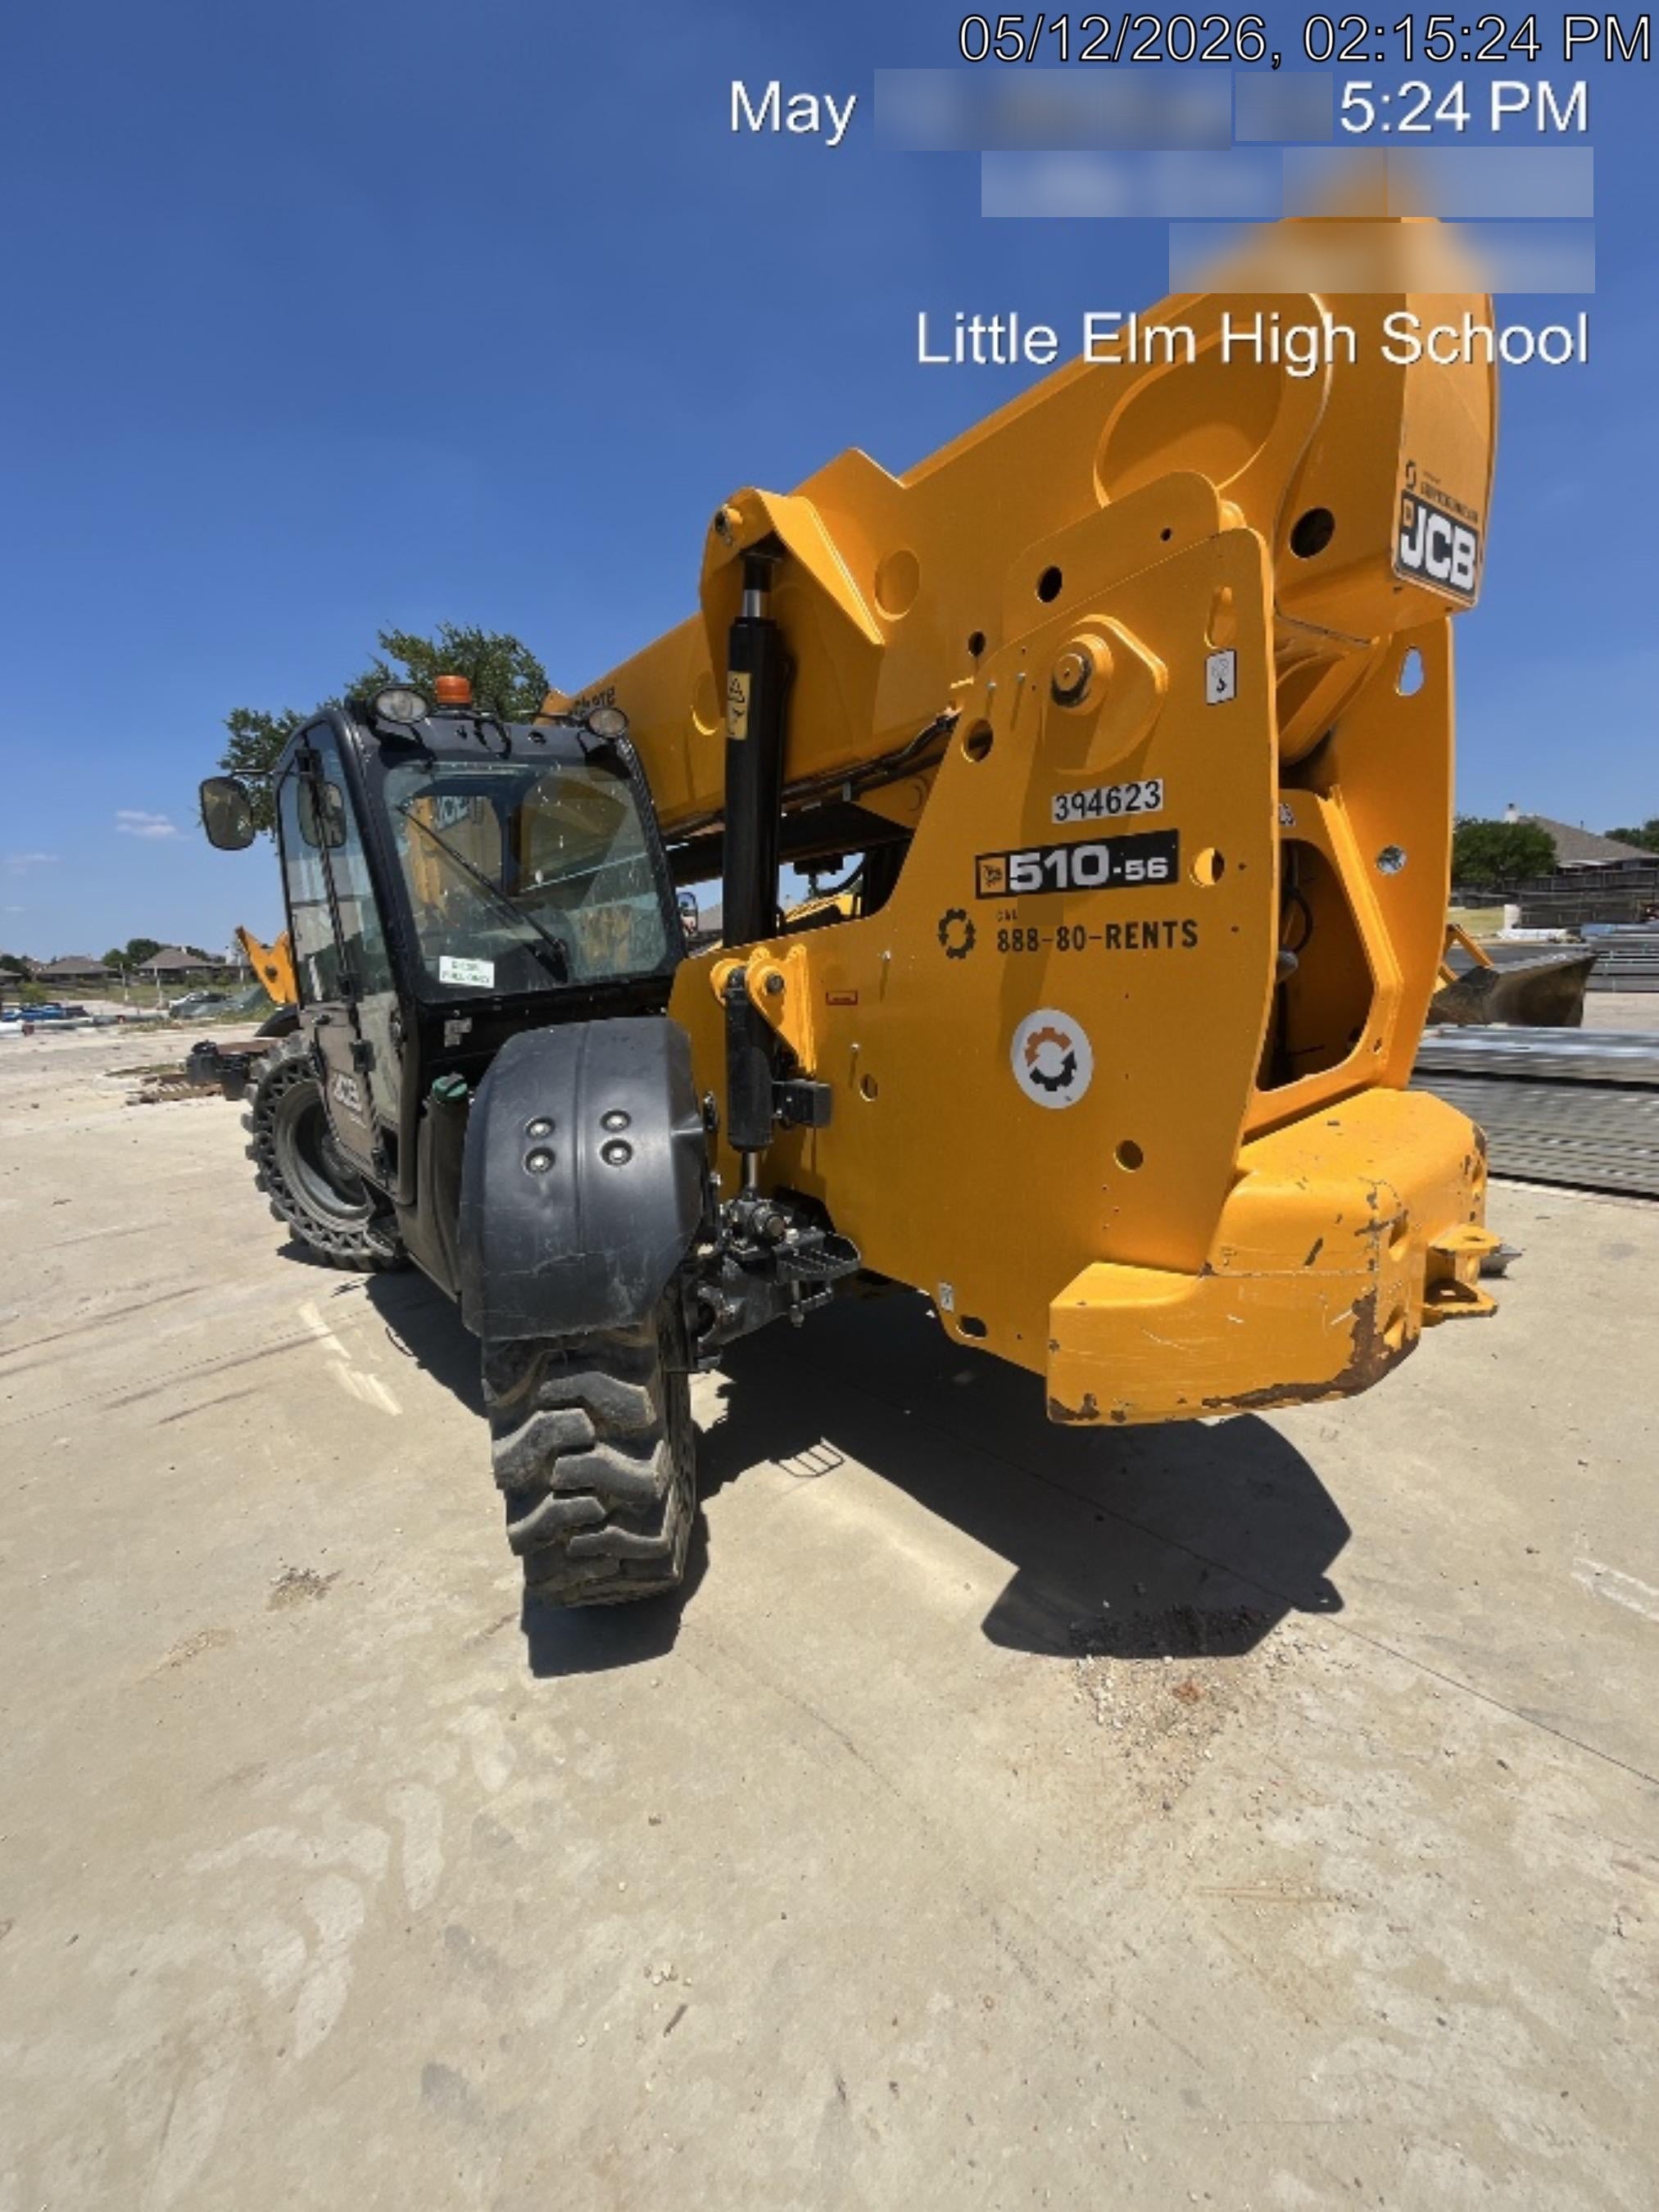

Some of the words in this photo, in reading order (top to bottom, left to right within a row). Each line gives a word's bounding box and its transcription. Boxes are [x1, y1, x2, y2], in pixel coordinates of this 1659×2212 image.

[1401, 505, 1475, 591] JCB
[1054, 781, 1161, 821] 394623
[997, 919, 1198, 953] 888-80-RENTS
